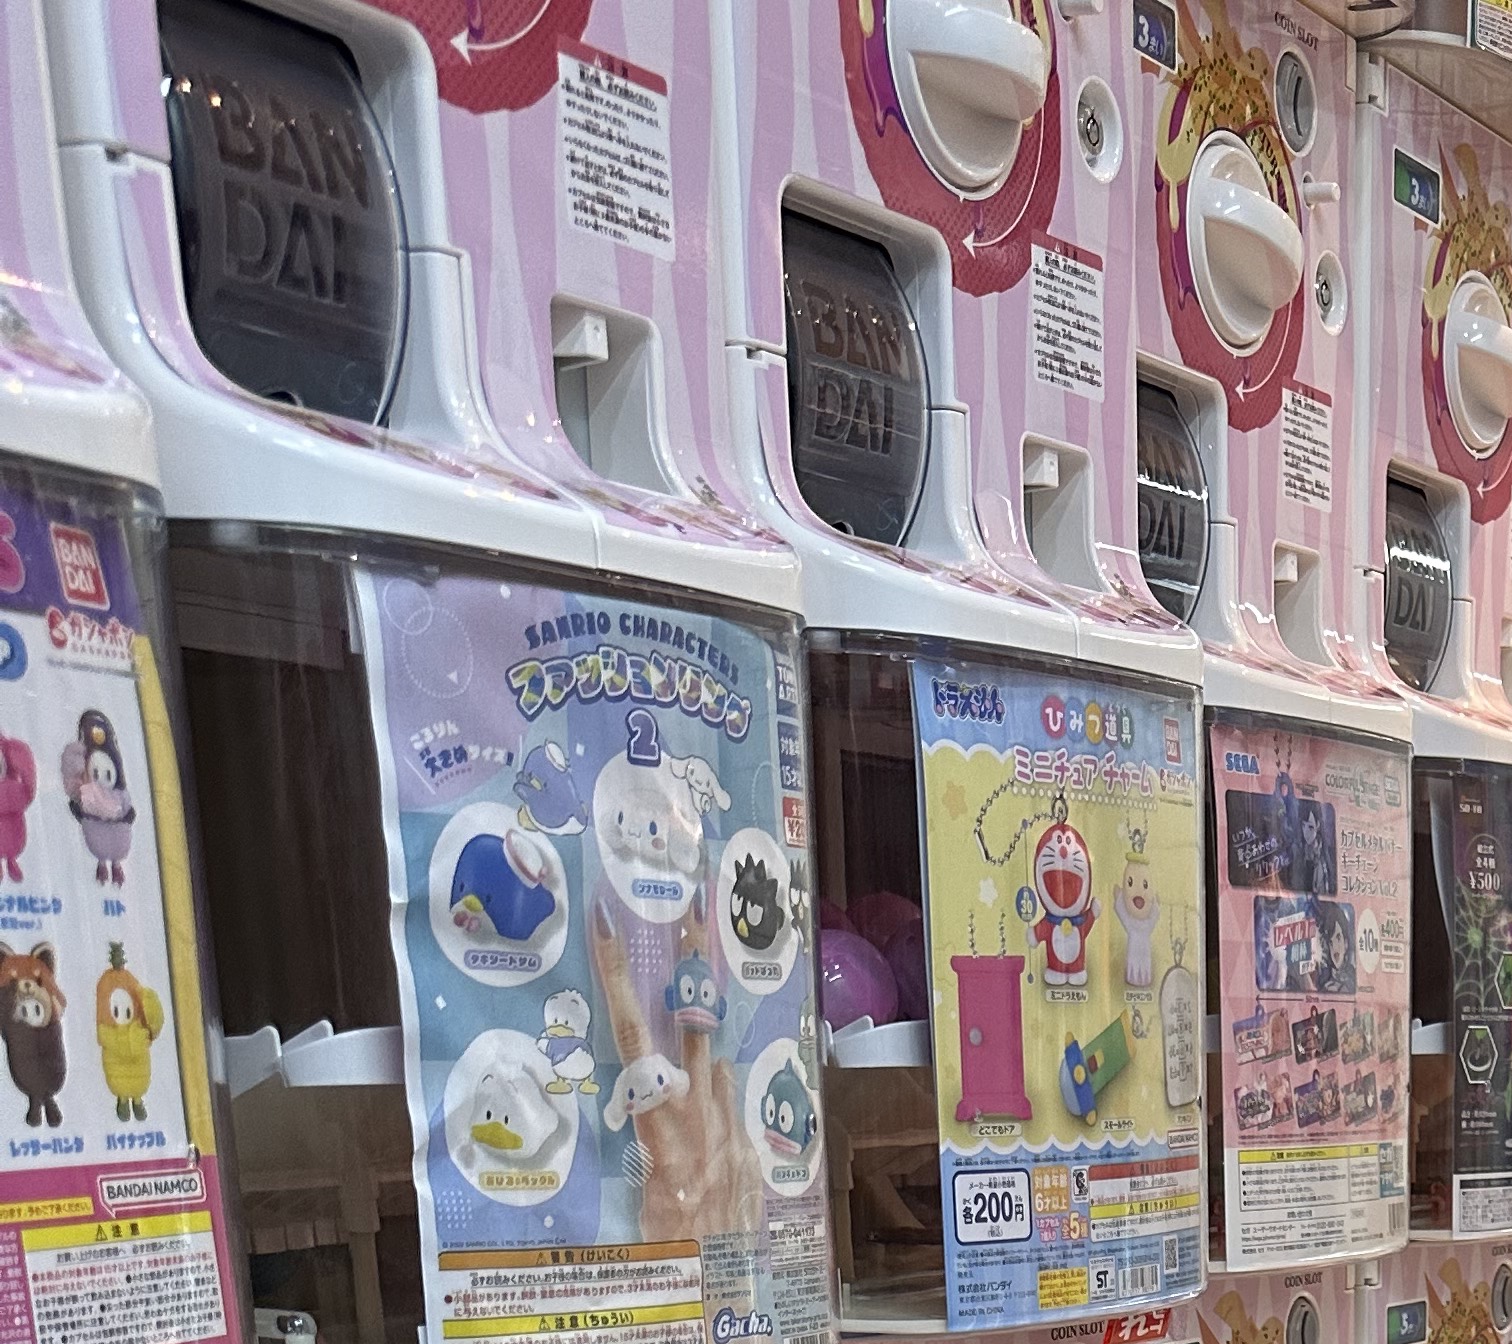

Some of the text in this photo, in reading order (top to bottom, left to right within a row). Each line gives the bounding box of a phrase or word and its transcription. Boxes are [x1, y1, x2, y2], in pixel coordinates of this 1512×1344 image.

[210, 78, 371, 208] BAN
[221, 178, 345, 306] DAI
[803, 280, 911, 382] BAN
[814, 361, 895, 456] DAI
[56, 537, 95, 569] BAN
[65, 565, 96, 593] DAI
[1396, 582, 1433, 631] DAI
[524, 611, 741, 684] SANRIO CHARACTERS
[506, 644, 752, 739] ファッションリング
[931, 678, 1006, 725] ドラえもん
[625, 708, 662, 767] 2
[1043, 703, 1132, 745] ひみつ道具
[1225, 752, 1260, 775] SEGA
[1468, 871, 1501, 891] ¥500
[107, 1131, 166, 1149] パイナップル
[978, 1125, 1016, 1136] どこでもドア
[107, 1178, 198, 1199] BANDAI NAMCO
[1034, 1174, 1068, 1189] 対象年齢
[963, 1191, 1025, 1225] 各200円
[1034, 1193, 1068, 1212] 6才以上
[112, 1223, 140, 1237] 注意
[714, 1310, 772, 1343] Gacha.
[1051, 1323, 1078, 1341] COIN
[1079, 1320, 1105, 1336] SLOT
